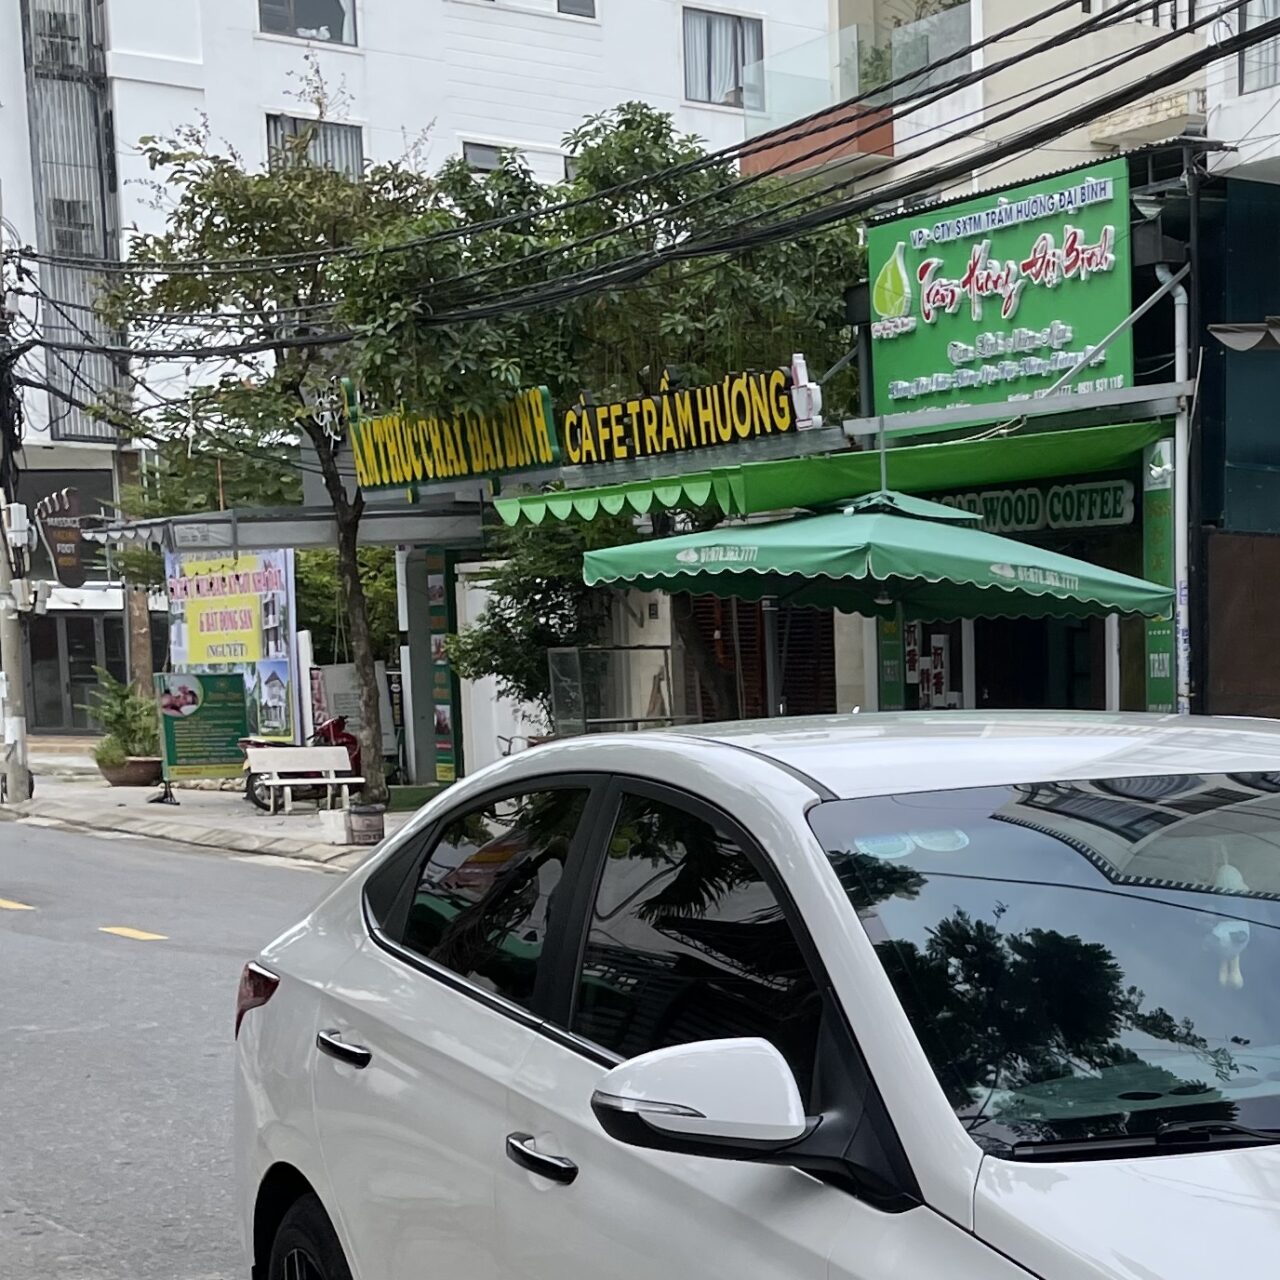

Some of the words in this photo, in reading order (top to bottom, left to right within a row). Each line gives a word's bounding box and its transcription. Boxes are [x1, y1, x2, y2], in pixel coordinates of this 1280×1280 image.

[911, 231, 925, 247] VP
[933, 224, 951, 241] CTY
[696, 369, 791, 446] HƯƠNG
[982, 494, 1040, 527] WOOD
[1049, 486, 1124, 525] COFFEE
